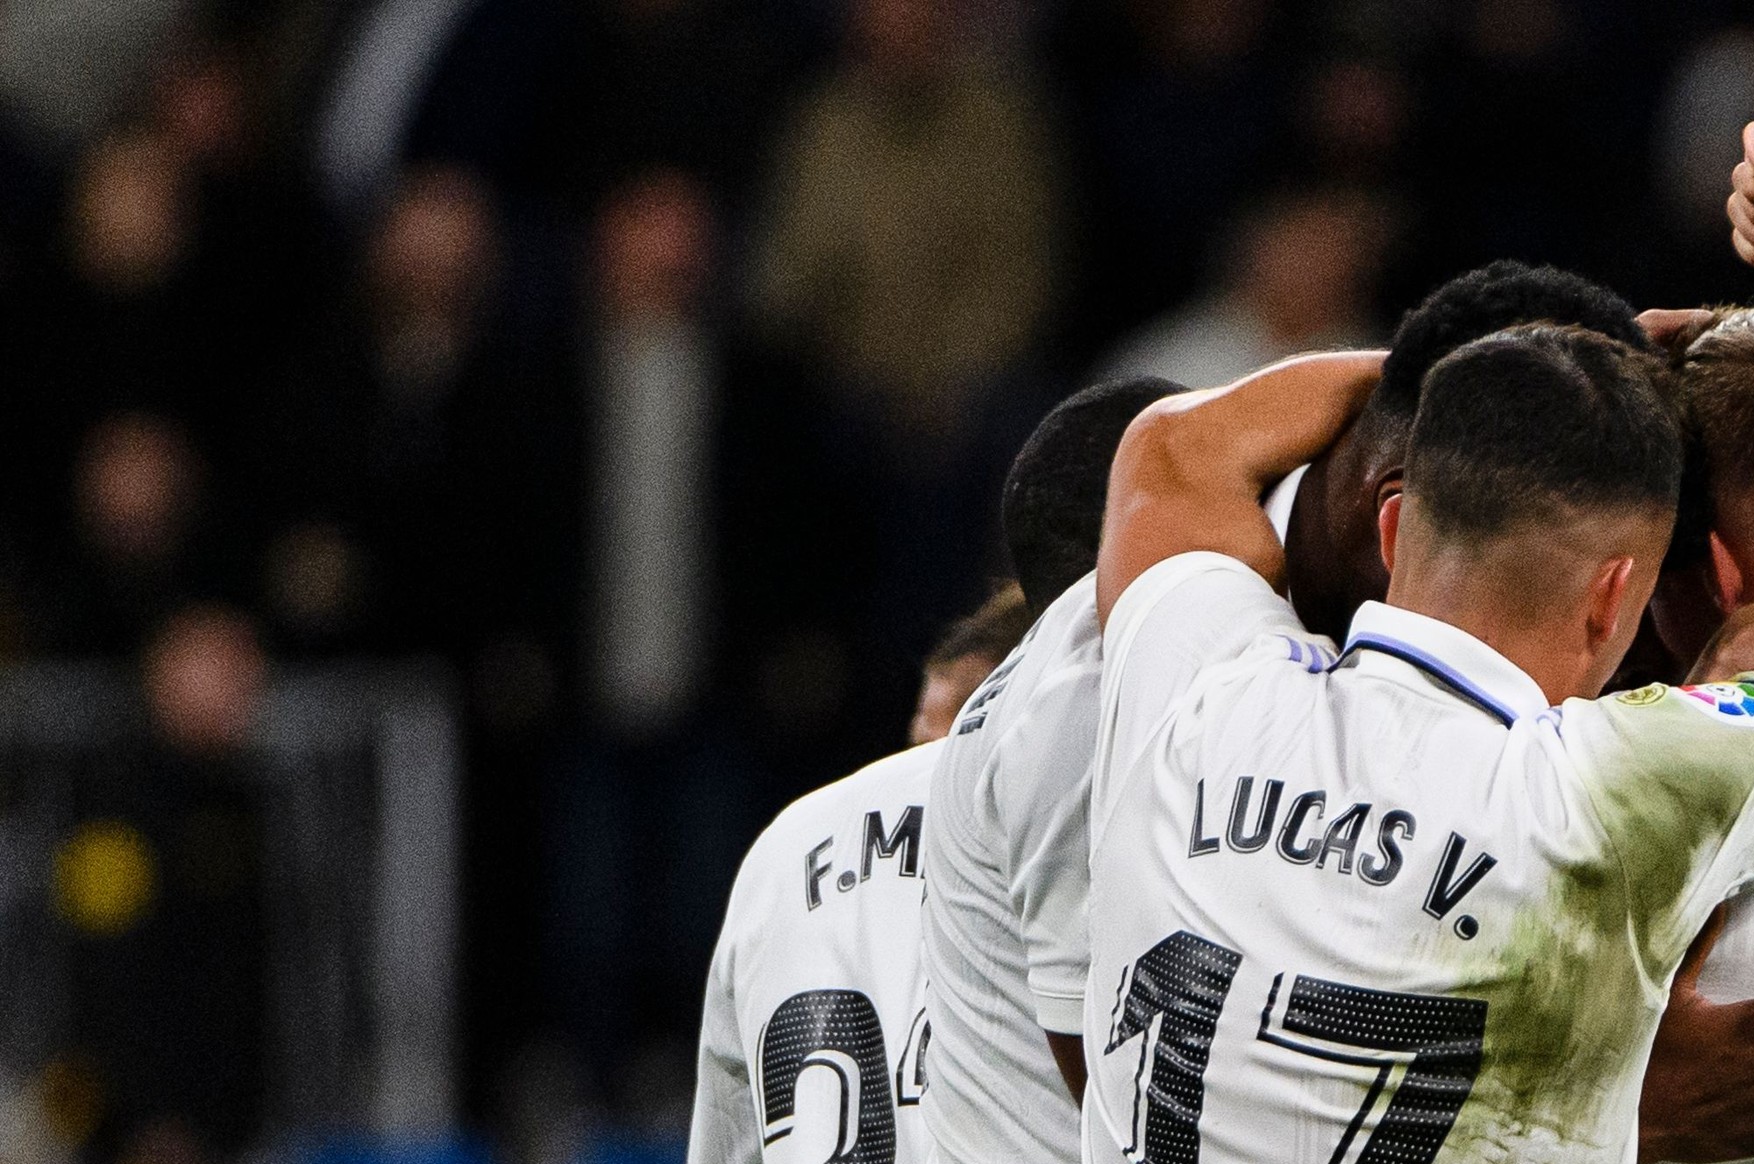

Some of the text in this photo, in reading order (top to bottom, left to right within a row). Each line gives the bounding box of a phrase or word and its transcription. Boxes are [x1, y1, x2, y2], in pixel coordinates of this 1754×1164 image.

[804, 805, 928, 912] F.M
[1187, 775, 1499, 941] LUCAS V.
